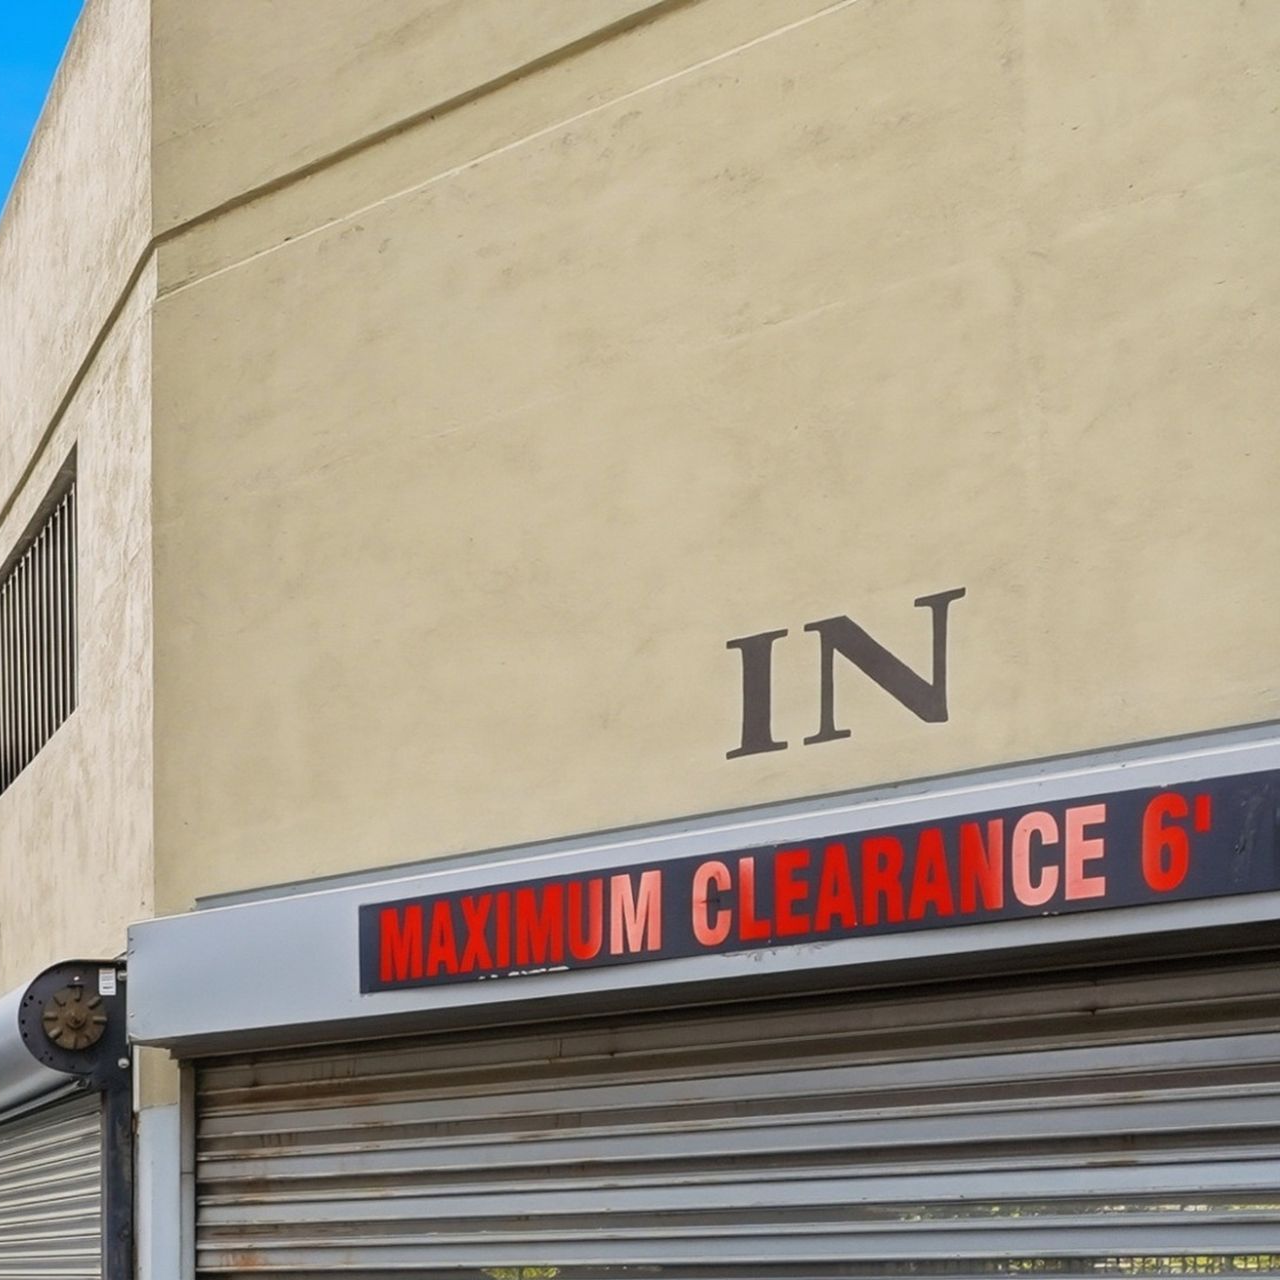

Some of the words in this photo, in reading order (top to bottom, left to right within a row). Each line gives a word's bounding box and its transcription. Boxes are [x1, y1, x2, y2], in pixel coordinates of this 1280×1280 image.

[725, 587, 966, 760] IN
[378, 869, 663, 983] MAXIMUM
[691, 803, 1107, 947] CLEARANCE
[1142, 791, 1212, 893] 6'
